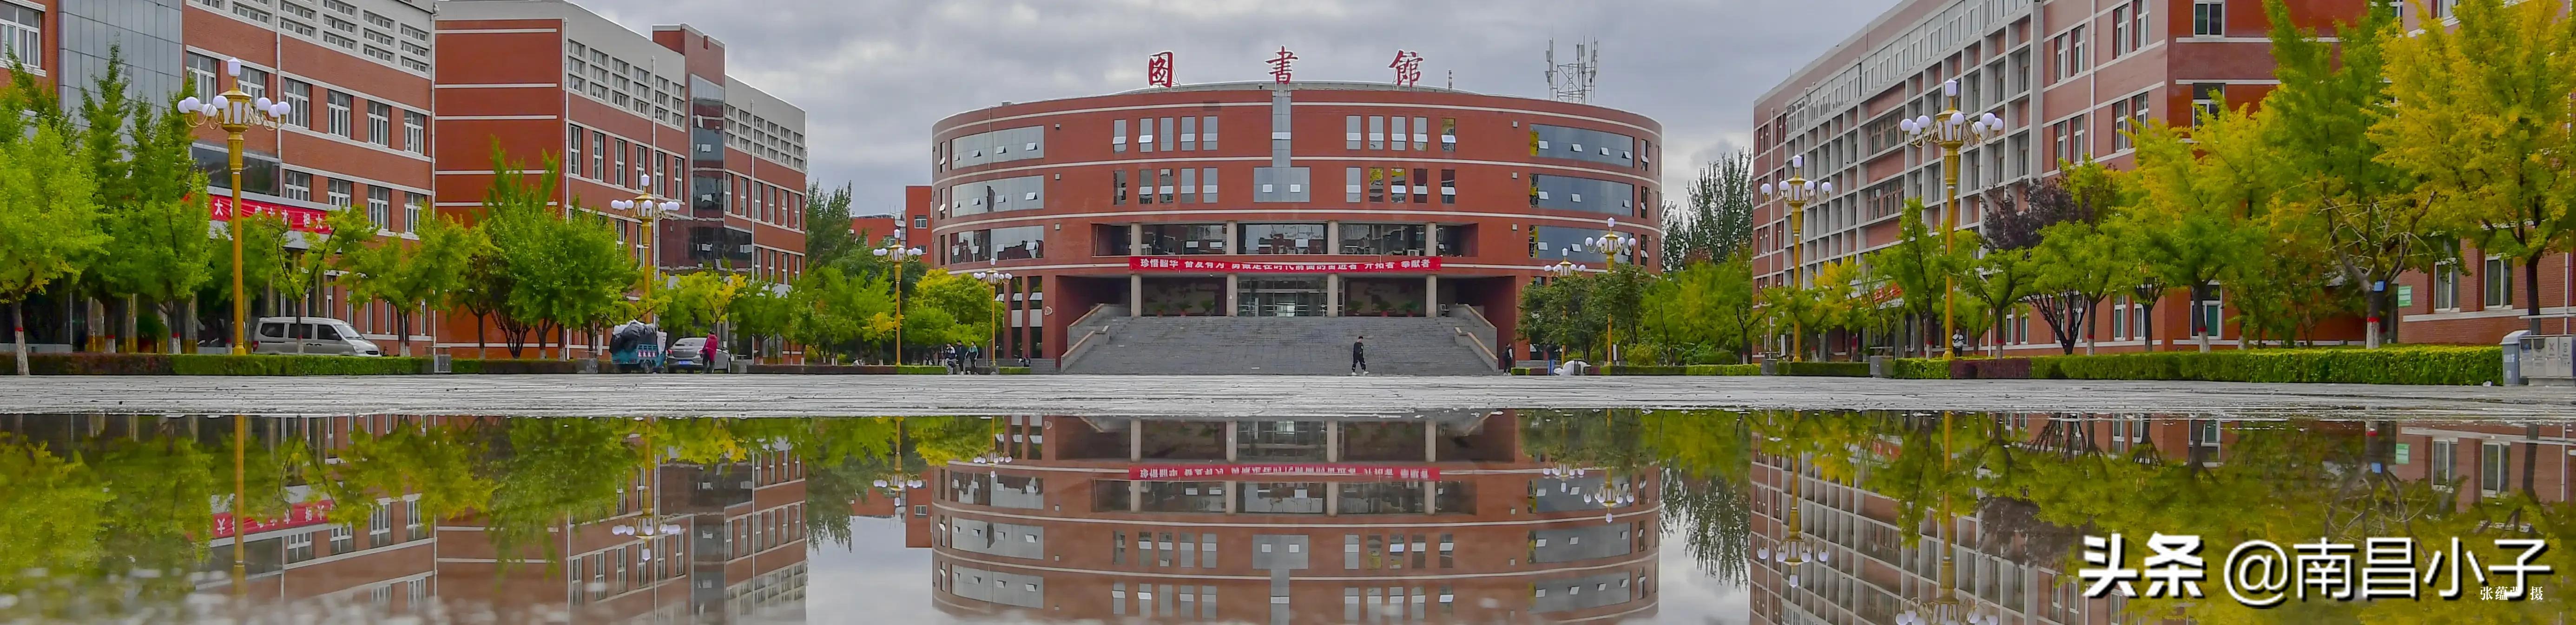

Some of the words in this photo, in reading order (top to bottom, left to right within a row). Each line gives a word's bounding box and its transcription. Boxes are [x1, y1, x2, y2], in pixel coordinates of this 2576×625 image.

[1140, 258, 1179, 268] 珍惜韶华
[1401, 259, 1430, 268] 奉献者
